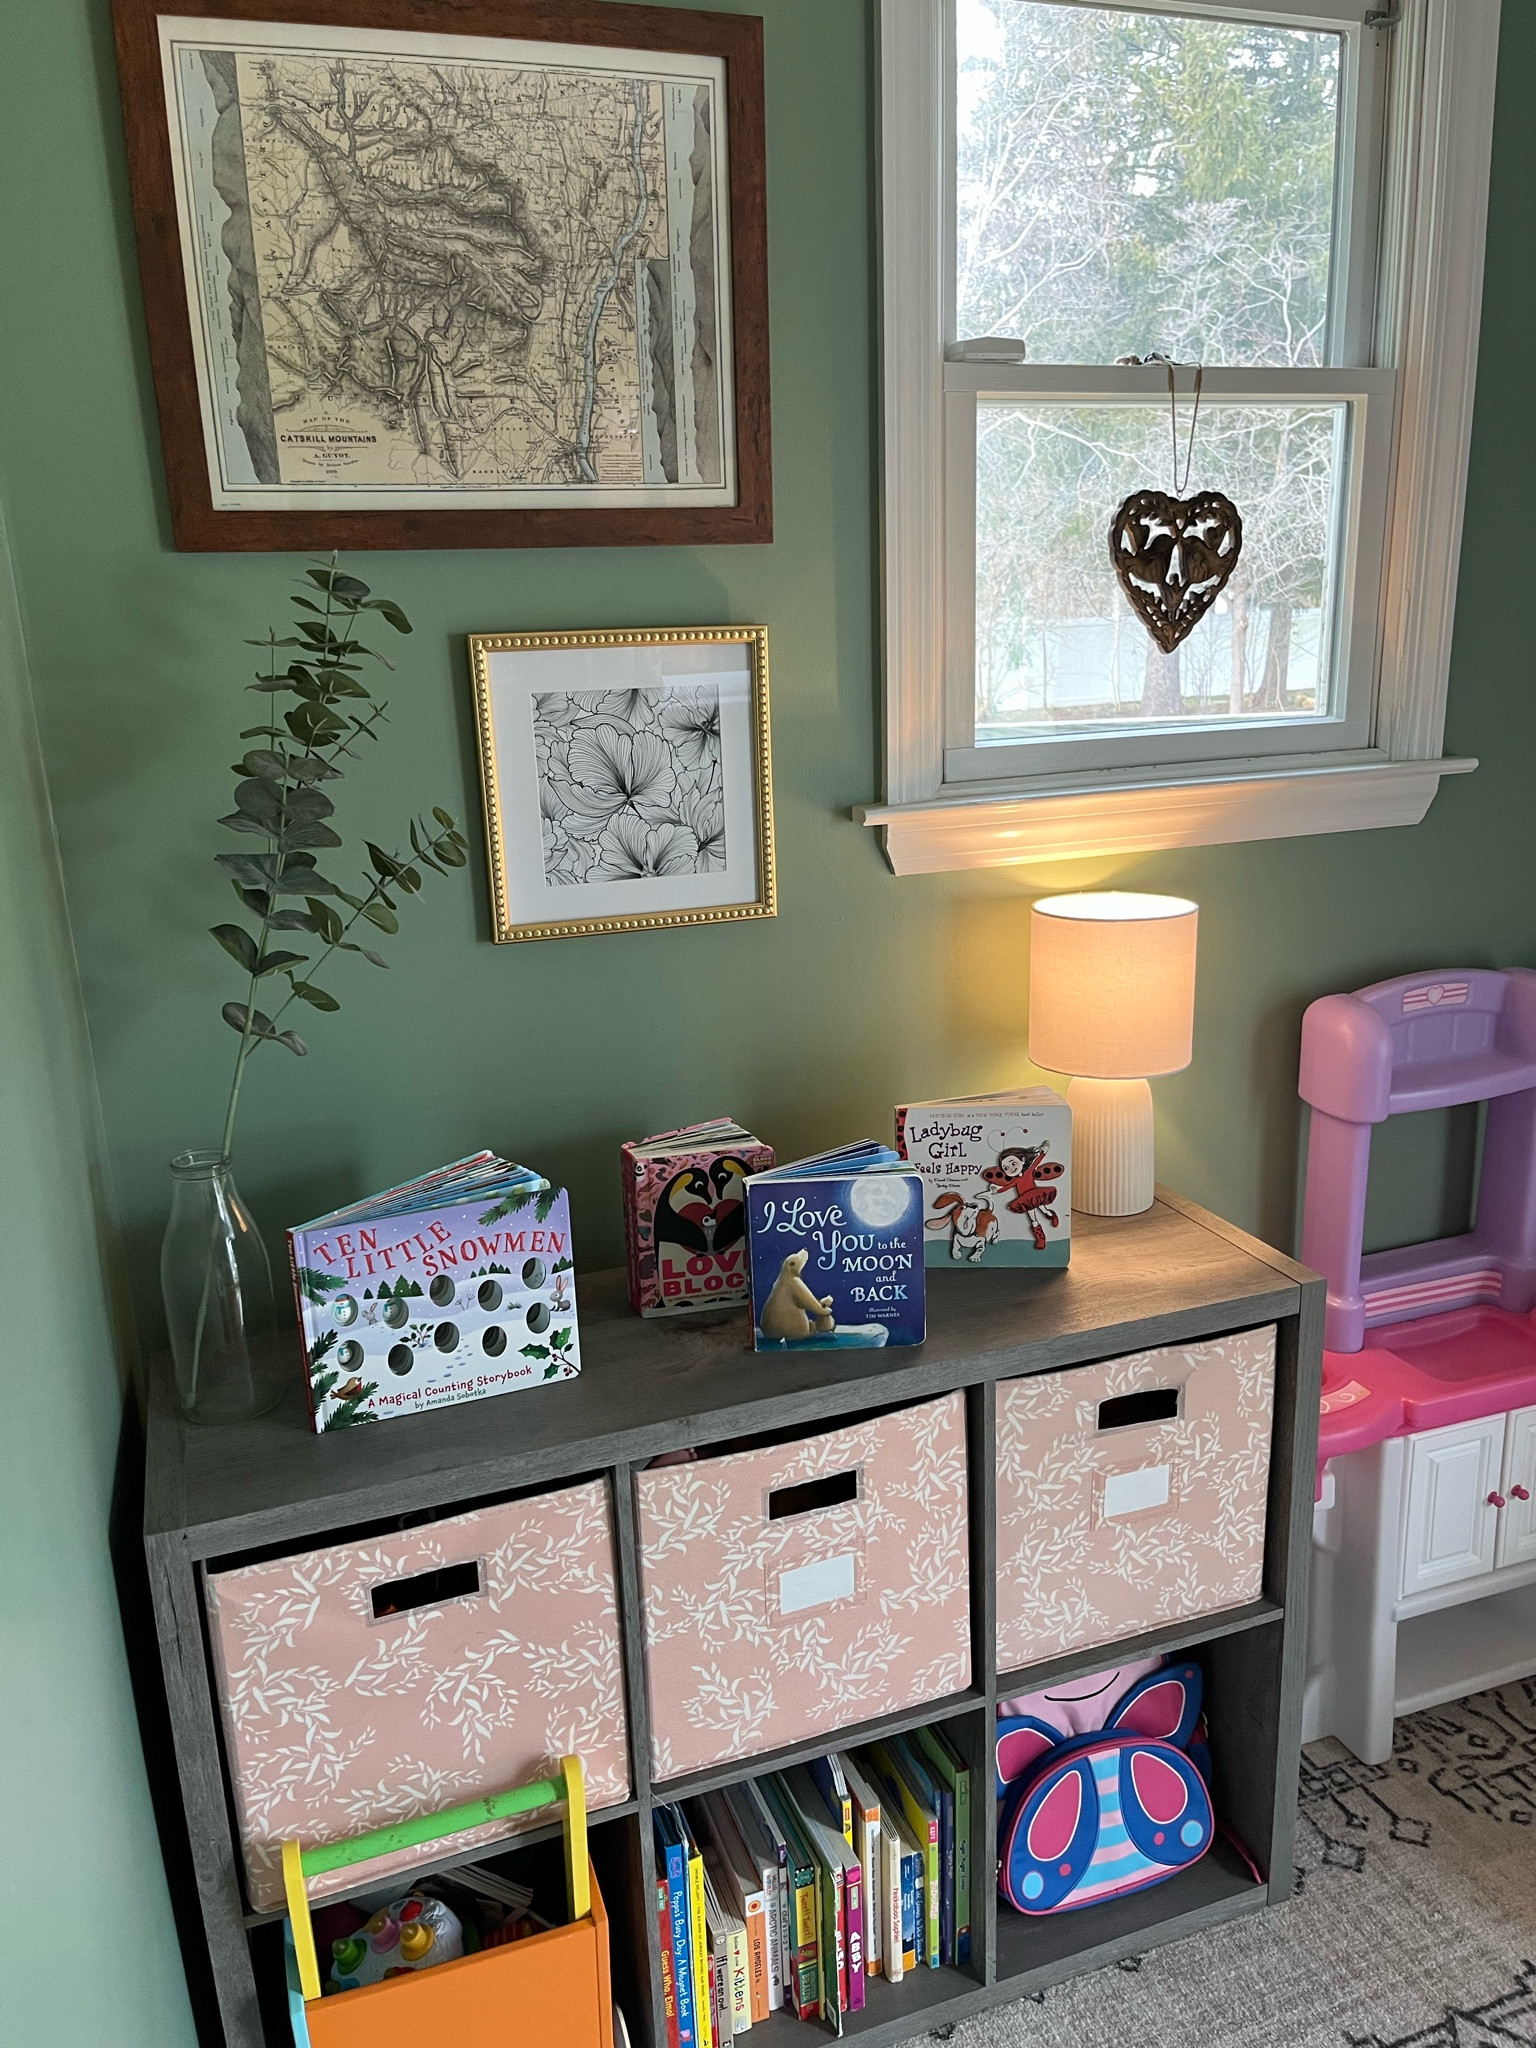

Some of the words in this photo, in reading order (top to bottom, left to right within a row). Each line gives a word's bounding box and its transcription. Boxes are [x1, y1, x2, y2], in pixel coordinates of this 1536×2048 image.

[280, 434, 327, 443] CATSKILL
[328, 435, 377, 443] MOUNTAINS
[909, 1121, 984, 1143] Ladybug
[914, 1162, 942, 1175] Feels
[945, 1162, 983, 1176] Happy
[756, 1200, 777, 1234] I
[776, 1197, 847, 1236] Love
[313, 1228, 378, 1267] TEN
[347, 1220, 452, 1279] LITTLE
[422, 1231, 567, 1278] SNOWMEN
[878, 1241, 888, 1250] to
[889, 1237, 908, 1249] the
[842, 1253, 913, 1273] MOON
[663, 1272, 745, 1298] BLOC
[875, 1270, 897, 1283] and
[850, 1284, 909, 1303] BACK
[368, 1398, 376, 1409] A
[379, 1388, 422, 1406] Magical
[425, 1378, 474, 1397] Counting
[477, 1365, 533, 1386] Storybook
[414, 1401, 425, 1410] by
[426, 1395, 455, 1407] Amanda
[456, 1387, 486, 1400] Sobotka
[670, 1890, 683, 1918] Peppa's
[892, 1887, 900, 1919] Peekaboo
[673, 1918, 685, 1938] Busy
[768, 1909, 778, 1938] ARCTIC
[781, 1910, 789, 1928] Olaf's
[753, 1938, 761, 1950] LOS
[849, 1931, 862, 1974] ABBY
[661, 1950, 670, 1974] Guess
[715, 1954, 728, 1963] If
[754, 1950, 762, 1978] ANGELES
[769, 1938, 780, 1974] ANIMALS
[676, 1967, 688, 1997] Magnet
[716, 1968, 724, 1987] were
[733, 1966, 746, 2012] Kittens
[802, 1974, 811, 2002] BRAUN
[717, 1987, 725, 1998] an
[664, 1995, 675, 2018] Elmo!
[680, 1998, 690, 2018] Book
